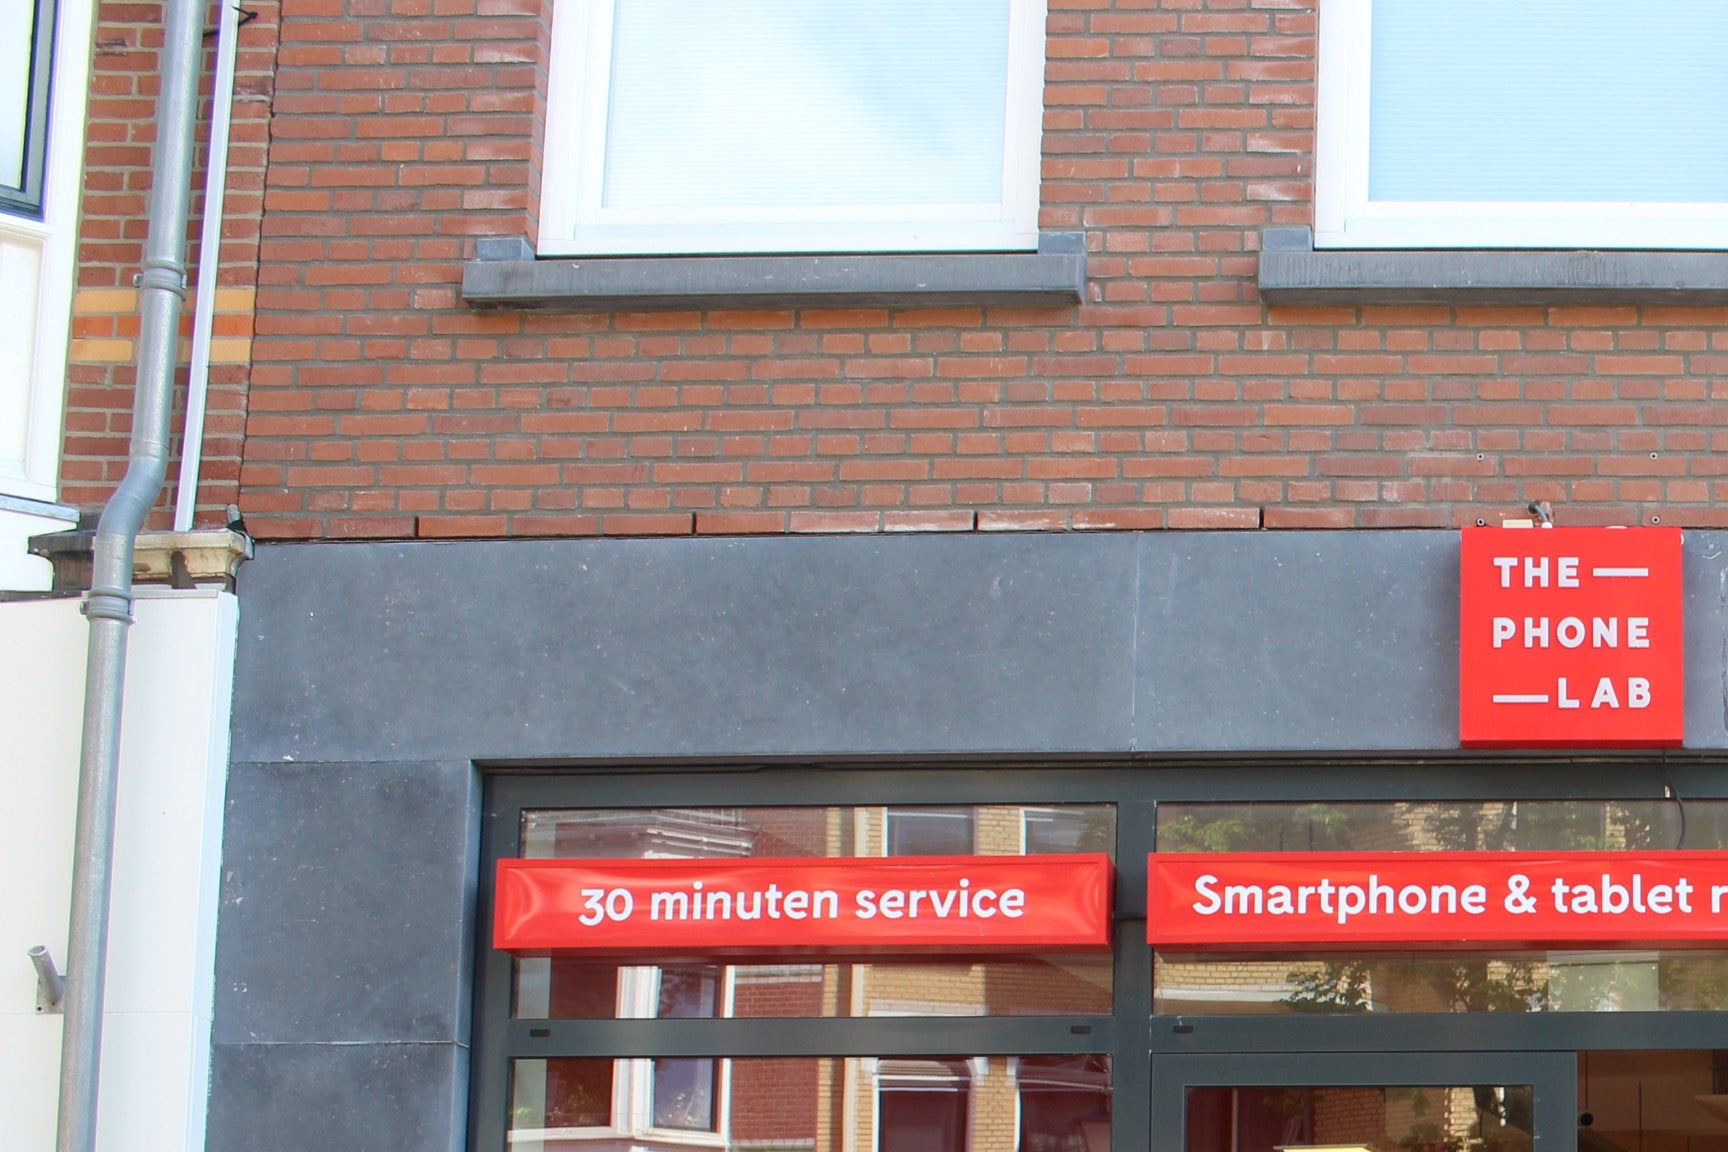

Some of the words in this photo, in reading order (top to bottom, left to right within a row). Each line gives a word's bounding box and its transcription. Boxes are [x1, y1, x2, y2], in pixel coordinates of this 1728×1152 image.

[1493, 556, 1580, 588] THE
[1493, 617, 1650, 648] PHONE
[1558, 677, 1651, 708] LAB
[578, 887, 634, 926] 30
[650, 880, 839, 921] minuten
[855, 878, 1026, 920] service
[1193, 874, 1487, 925] Smartphone
[1504, 875, 1537, 914] &
[1552, 874, 1694, 915] tablet
